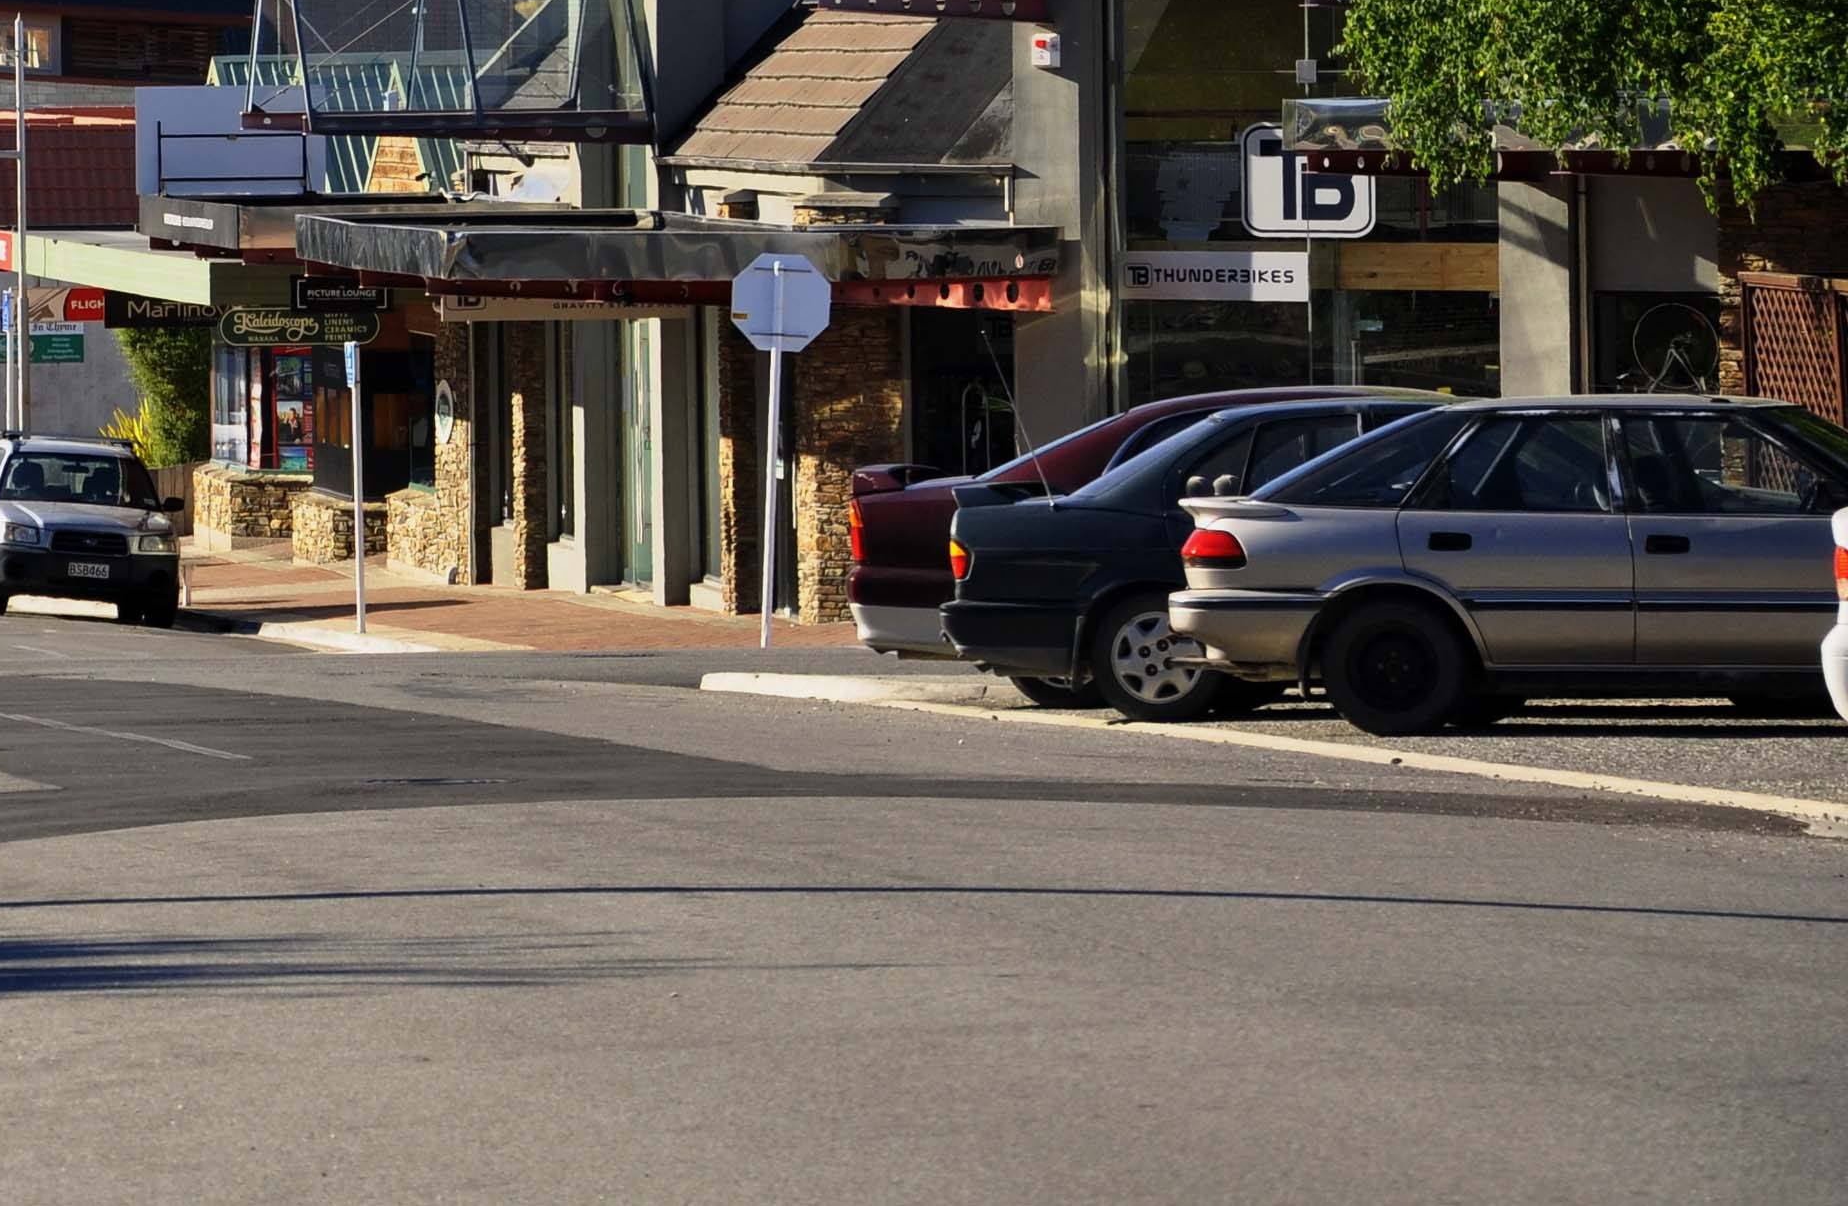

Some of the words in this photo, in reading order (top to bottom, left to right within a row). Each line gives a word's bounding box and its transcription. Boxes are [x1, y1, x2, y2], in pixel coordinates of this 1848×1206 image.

[1154, 268, 1294, 284] THUNDERBIKES
[307, 289, 340, 297] PICTURE
[342, 289, 377, 297] LOUNGE
[71, 299, 104, 310] FLIGH
[233, 312, 319, 342] Kaleidoscope
